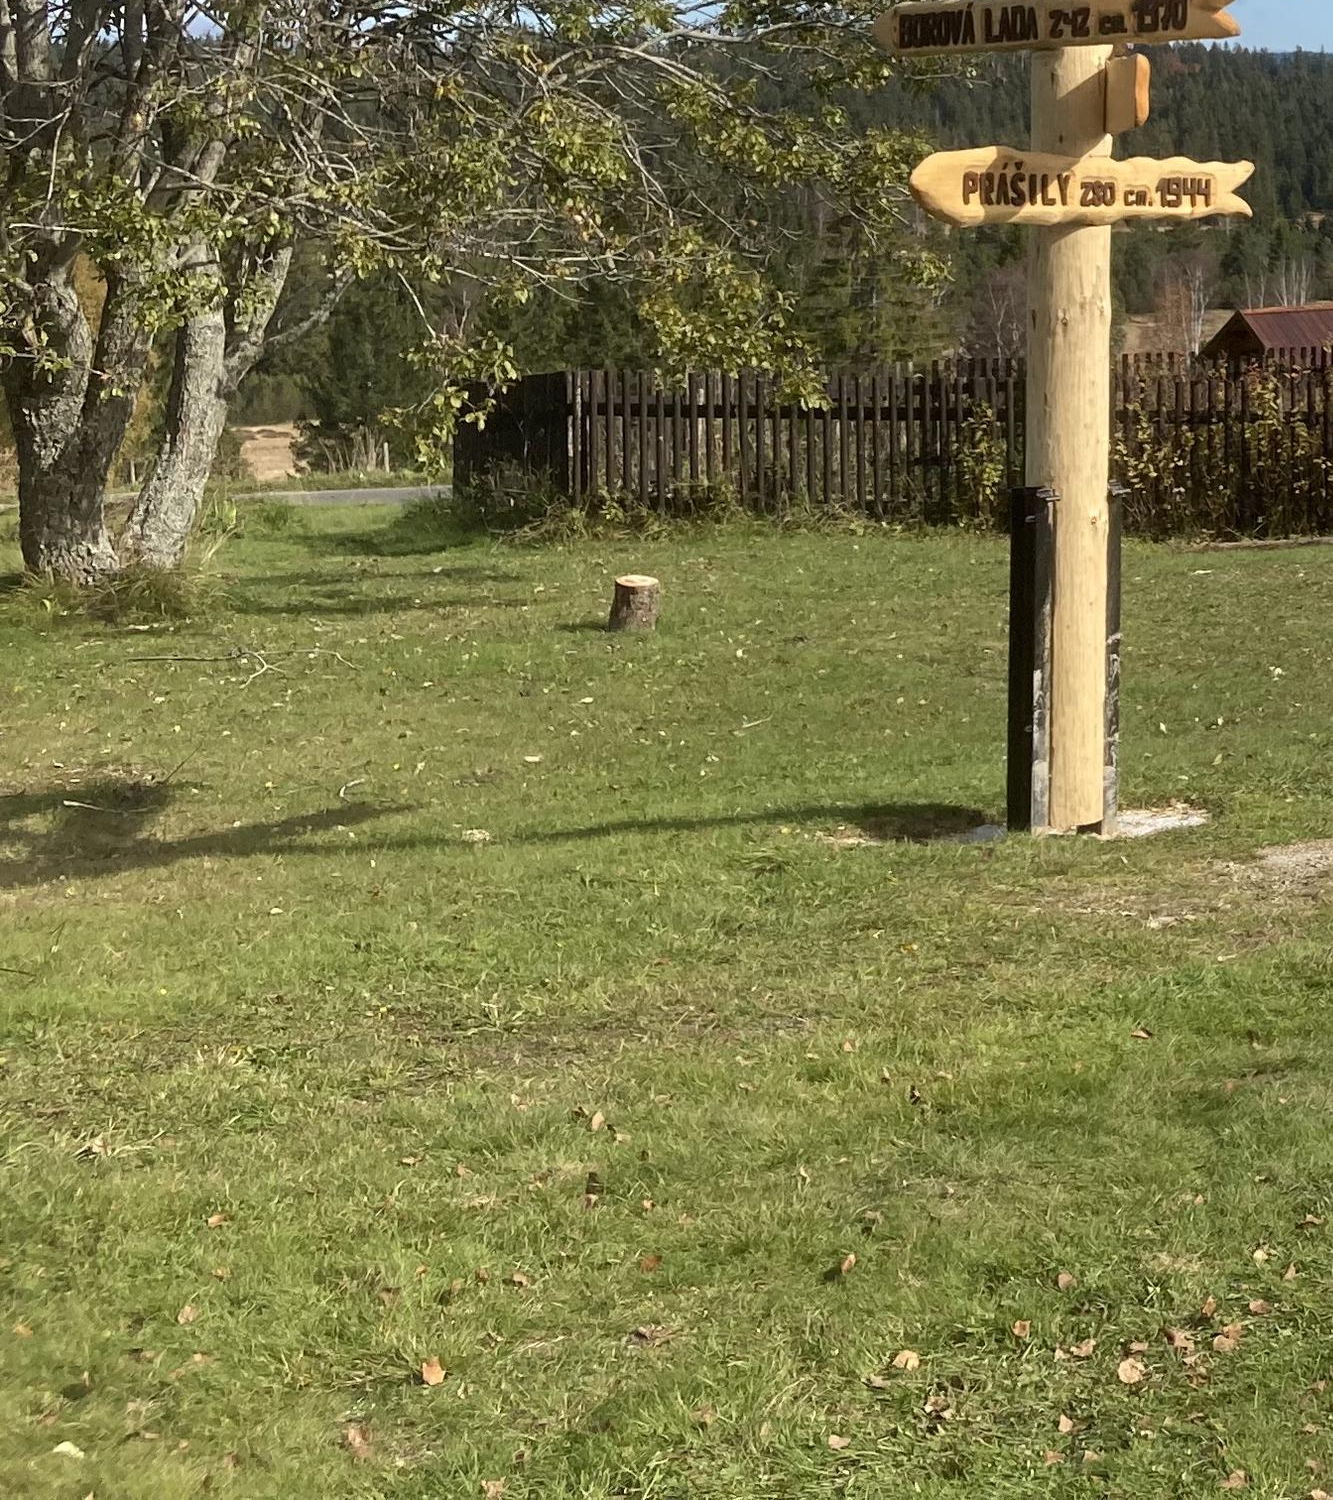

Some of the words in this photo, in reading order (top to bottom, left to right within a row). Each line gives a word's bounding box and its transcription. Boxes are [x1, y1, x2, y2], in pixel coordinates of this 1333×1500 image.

[899, 3, 976, 49] BOROVÁ
[984, 5, 1039, 44] LADA
[1049, 7, 1091, 38] 242
[962, 161, 1072, 206] PRÁŠILY
[1080, 180, 1116, 207] 280
[1155, 176, 1211, 208] 1944
